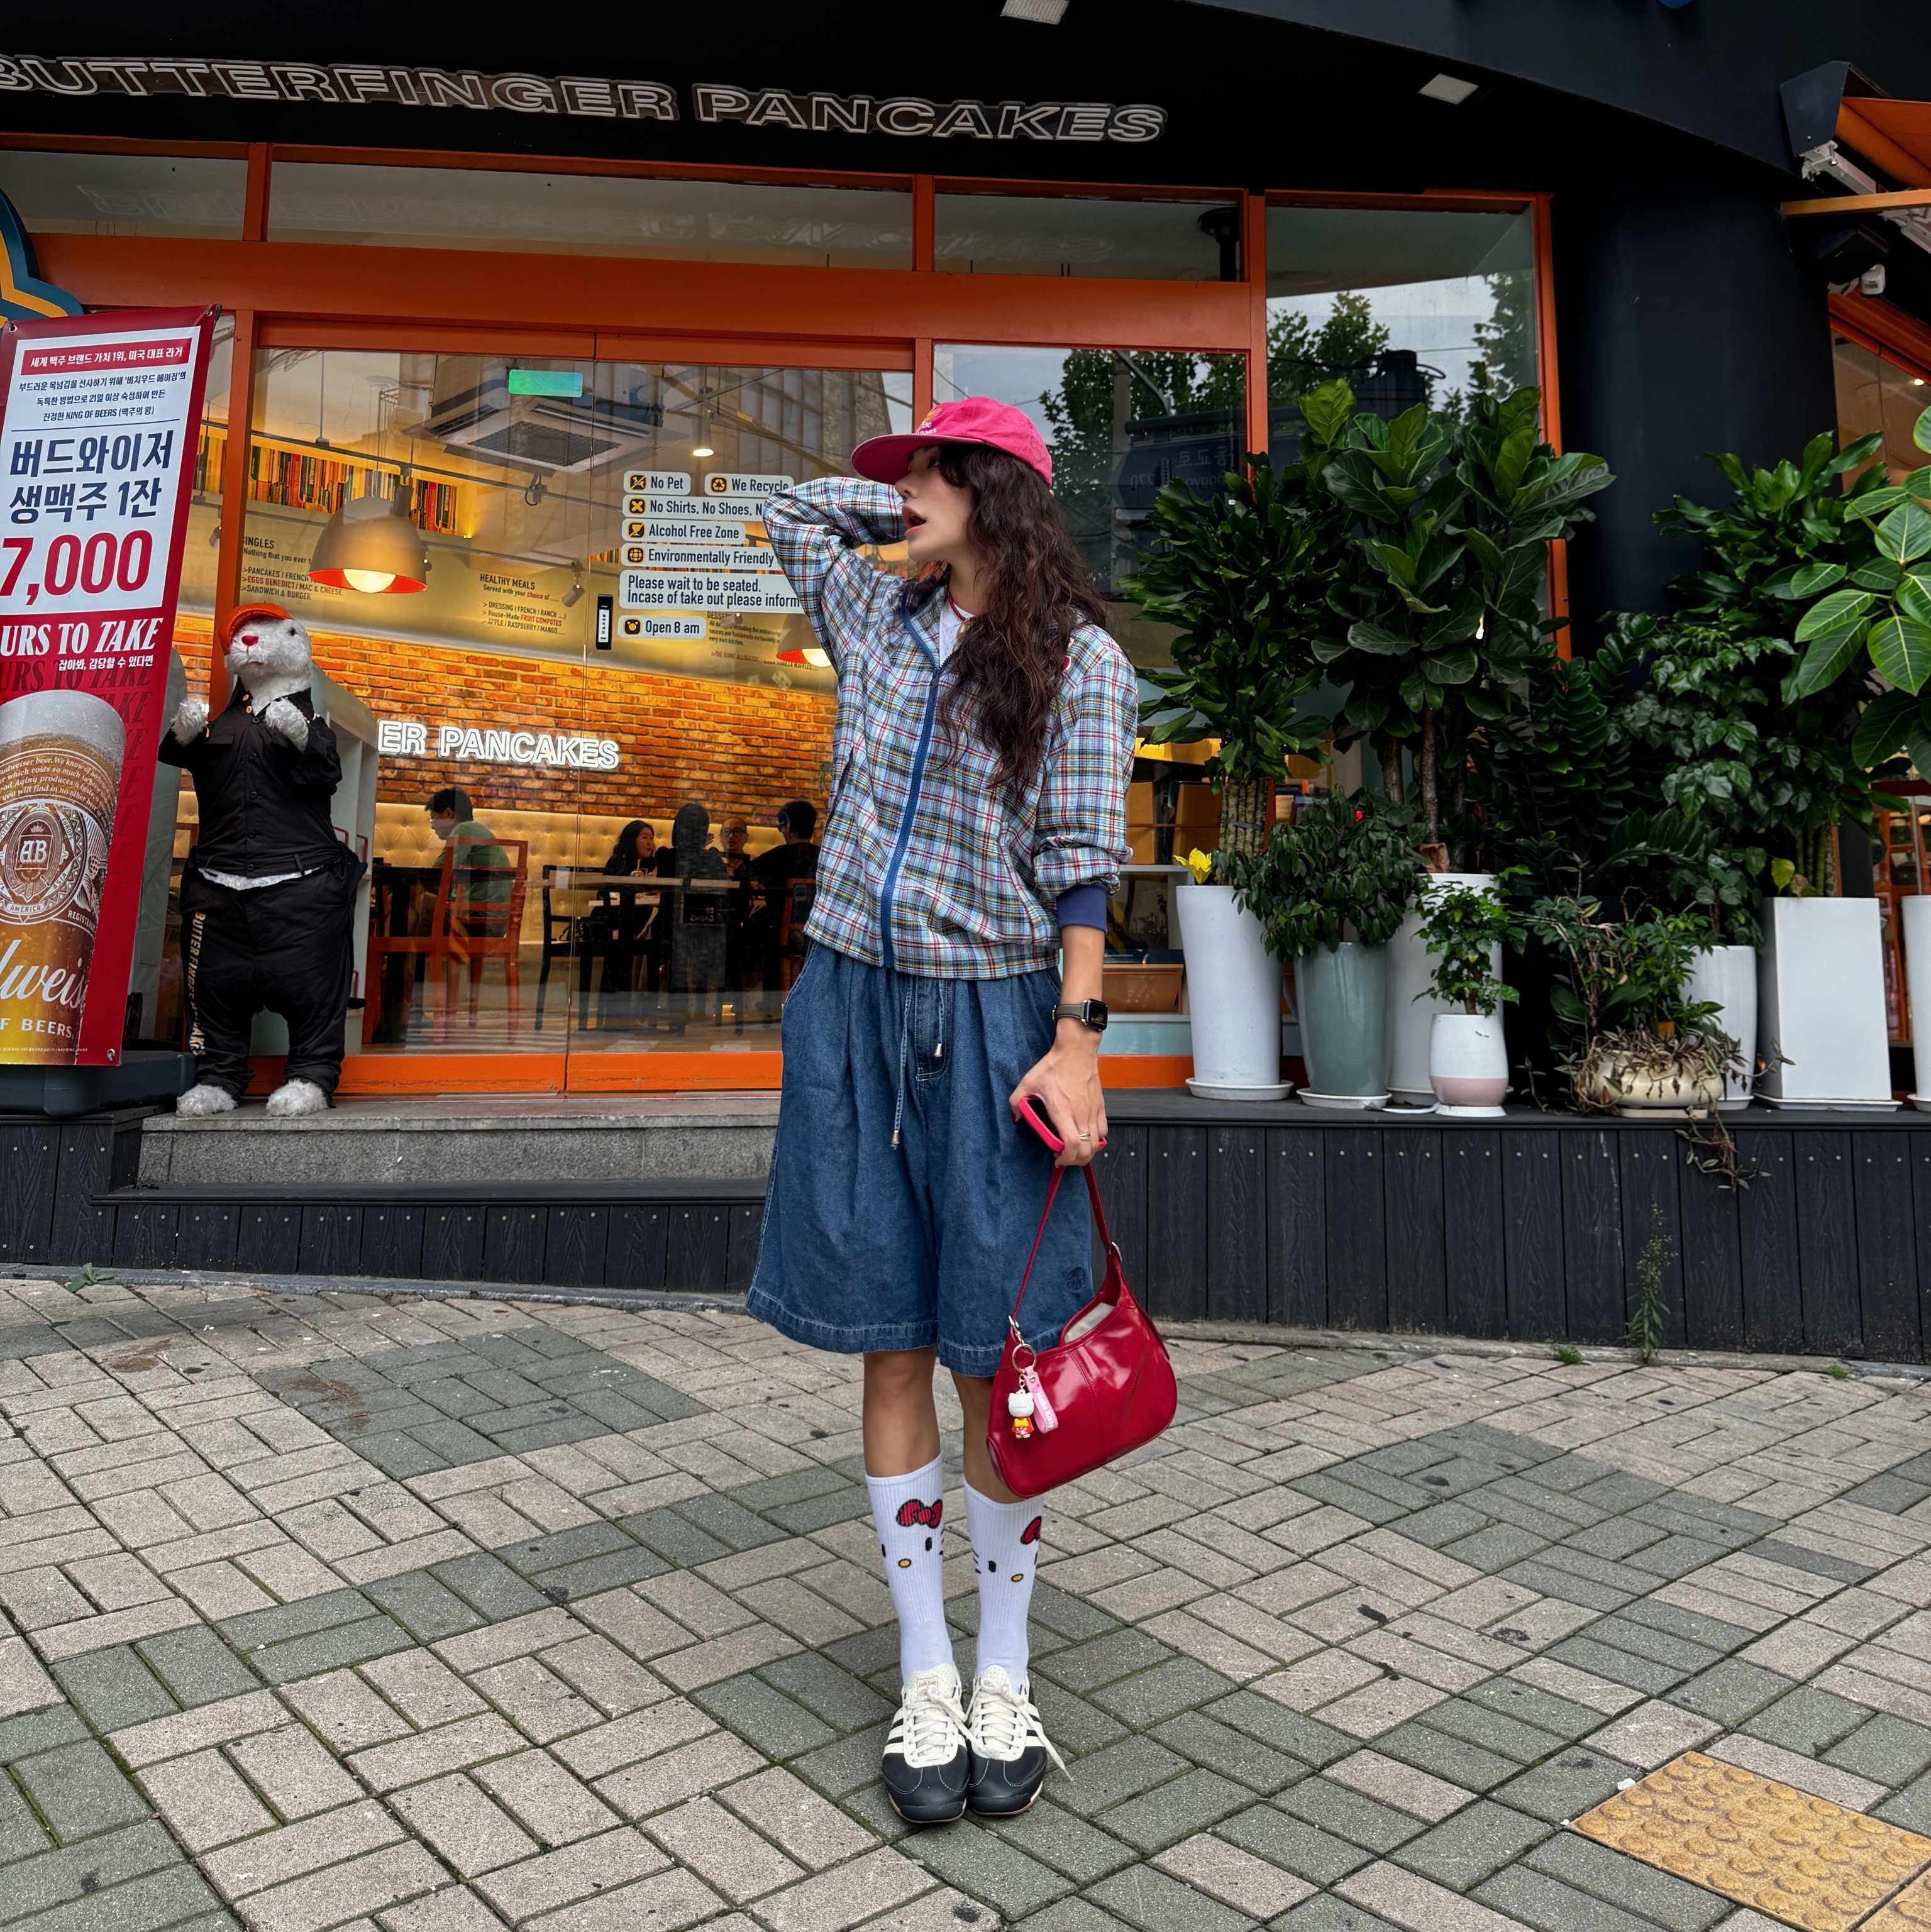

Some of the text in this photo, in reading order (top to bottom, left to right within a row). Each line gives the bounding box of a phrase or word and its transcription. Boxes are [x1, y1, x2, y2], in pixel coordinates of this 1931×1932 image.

[0, 57, 1165, 142] BUTTERFINGER PANCAKES
[30, 356, 48, 367] 세계
[50, 355, 66, 366] 맥주
[67, 353, 92, 365] 브랜드
[94, 351, 111, 363] 가치
[128, 350, 145, 360] 미국
[147, 348, 164, 359] 대표
[165, 346, 183, 358] 라거
[19, 382, 48, 392] 부드러운
[50, 380, 77, 390] 목넘김을
[79, 377, 107, 388] 선사하기
[109, 377, 123, 385] 위해
[36, 389, 165, 406] 독특한 방법으로 21일 이상 숙성하여 만든
[43, 412, 64, 421] 진정한
[65, 411, 82, 420] KING
[84, 410, 94, 419] OF
[95, 409, 117, 417] BEERS
[10, 429, 174, 478] 버드와이저
[651, 476, 683, 490] No Pet
[731, 478, 788, 494] We Recycle
[9, 477, 162, 524] 생맥주 1잔
[650, 500, 663, 512] No
[667, 500, 699, 515] Shirts,
[702, 502, 716, 514] No
[719, 502, 753, 517] Shoes,
[649, 523, 739, 539] Alcohol Free Zone
[243, 548, 267, 559] Nothing
[268, 551, 280, 560] that
[648, 549, 775, 566] Environmentally Friendly
[0, 529, 153, 606] 7,000
[248, 576, 263, 584] EGGS
[299, 583, 313, 592] MAC
[320, 586, 342, 595] CHEESE
[285, 573, 309, 582] FRENCH
[480, 573, 535, 590] HEALTHY MEALS
[628, 575, 761, 593] Please wait to be seated.
[287, 591, 311, 600] BURGER
[483, 584, 502, 593] Served
[628, 590, 800, 609] Incase of take out please inform
[489, 601, 514, 611] DRESSING
[541, 609, 556, 618] RANCH
[487, 619, 505, 627] APPLE
[507, 621, 536, 631] RASPBERRY
[488, 610, 562, 627] House-Made FRUIT COMPOTES
[57, 622, 90, 654] TO
[94, 617, 164, 653] TAKE
[645, 621, 700, 636] Open 8 am
[58, 654, 154, 671] 잡아봐, 감당할 수 있다면
[377, 719, 619, 770] ER PANCAKES
[0, 760, 34, 775] udweiser
[65, 760, 84, 770] know
[8, 768, 29, 780] which
[62, 768, 80, 778] much
[40, 776, 74, 786] produces
[3, 791, 16, 801] you
[18, 787, 31, 796] will
[33, 785, 49, 793] find
[69, 790, 86, 802] other
[62, 818, 74, 841] EUROPE
[53, 873, 67, 890] ASIA
[1036, 1392, 1055, 1428] Hello Kitty
